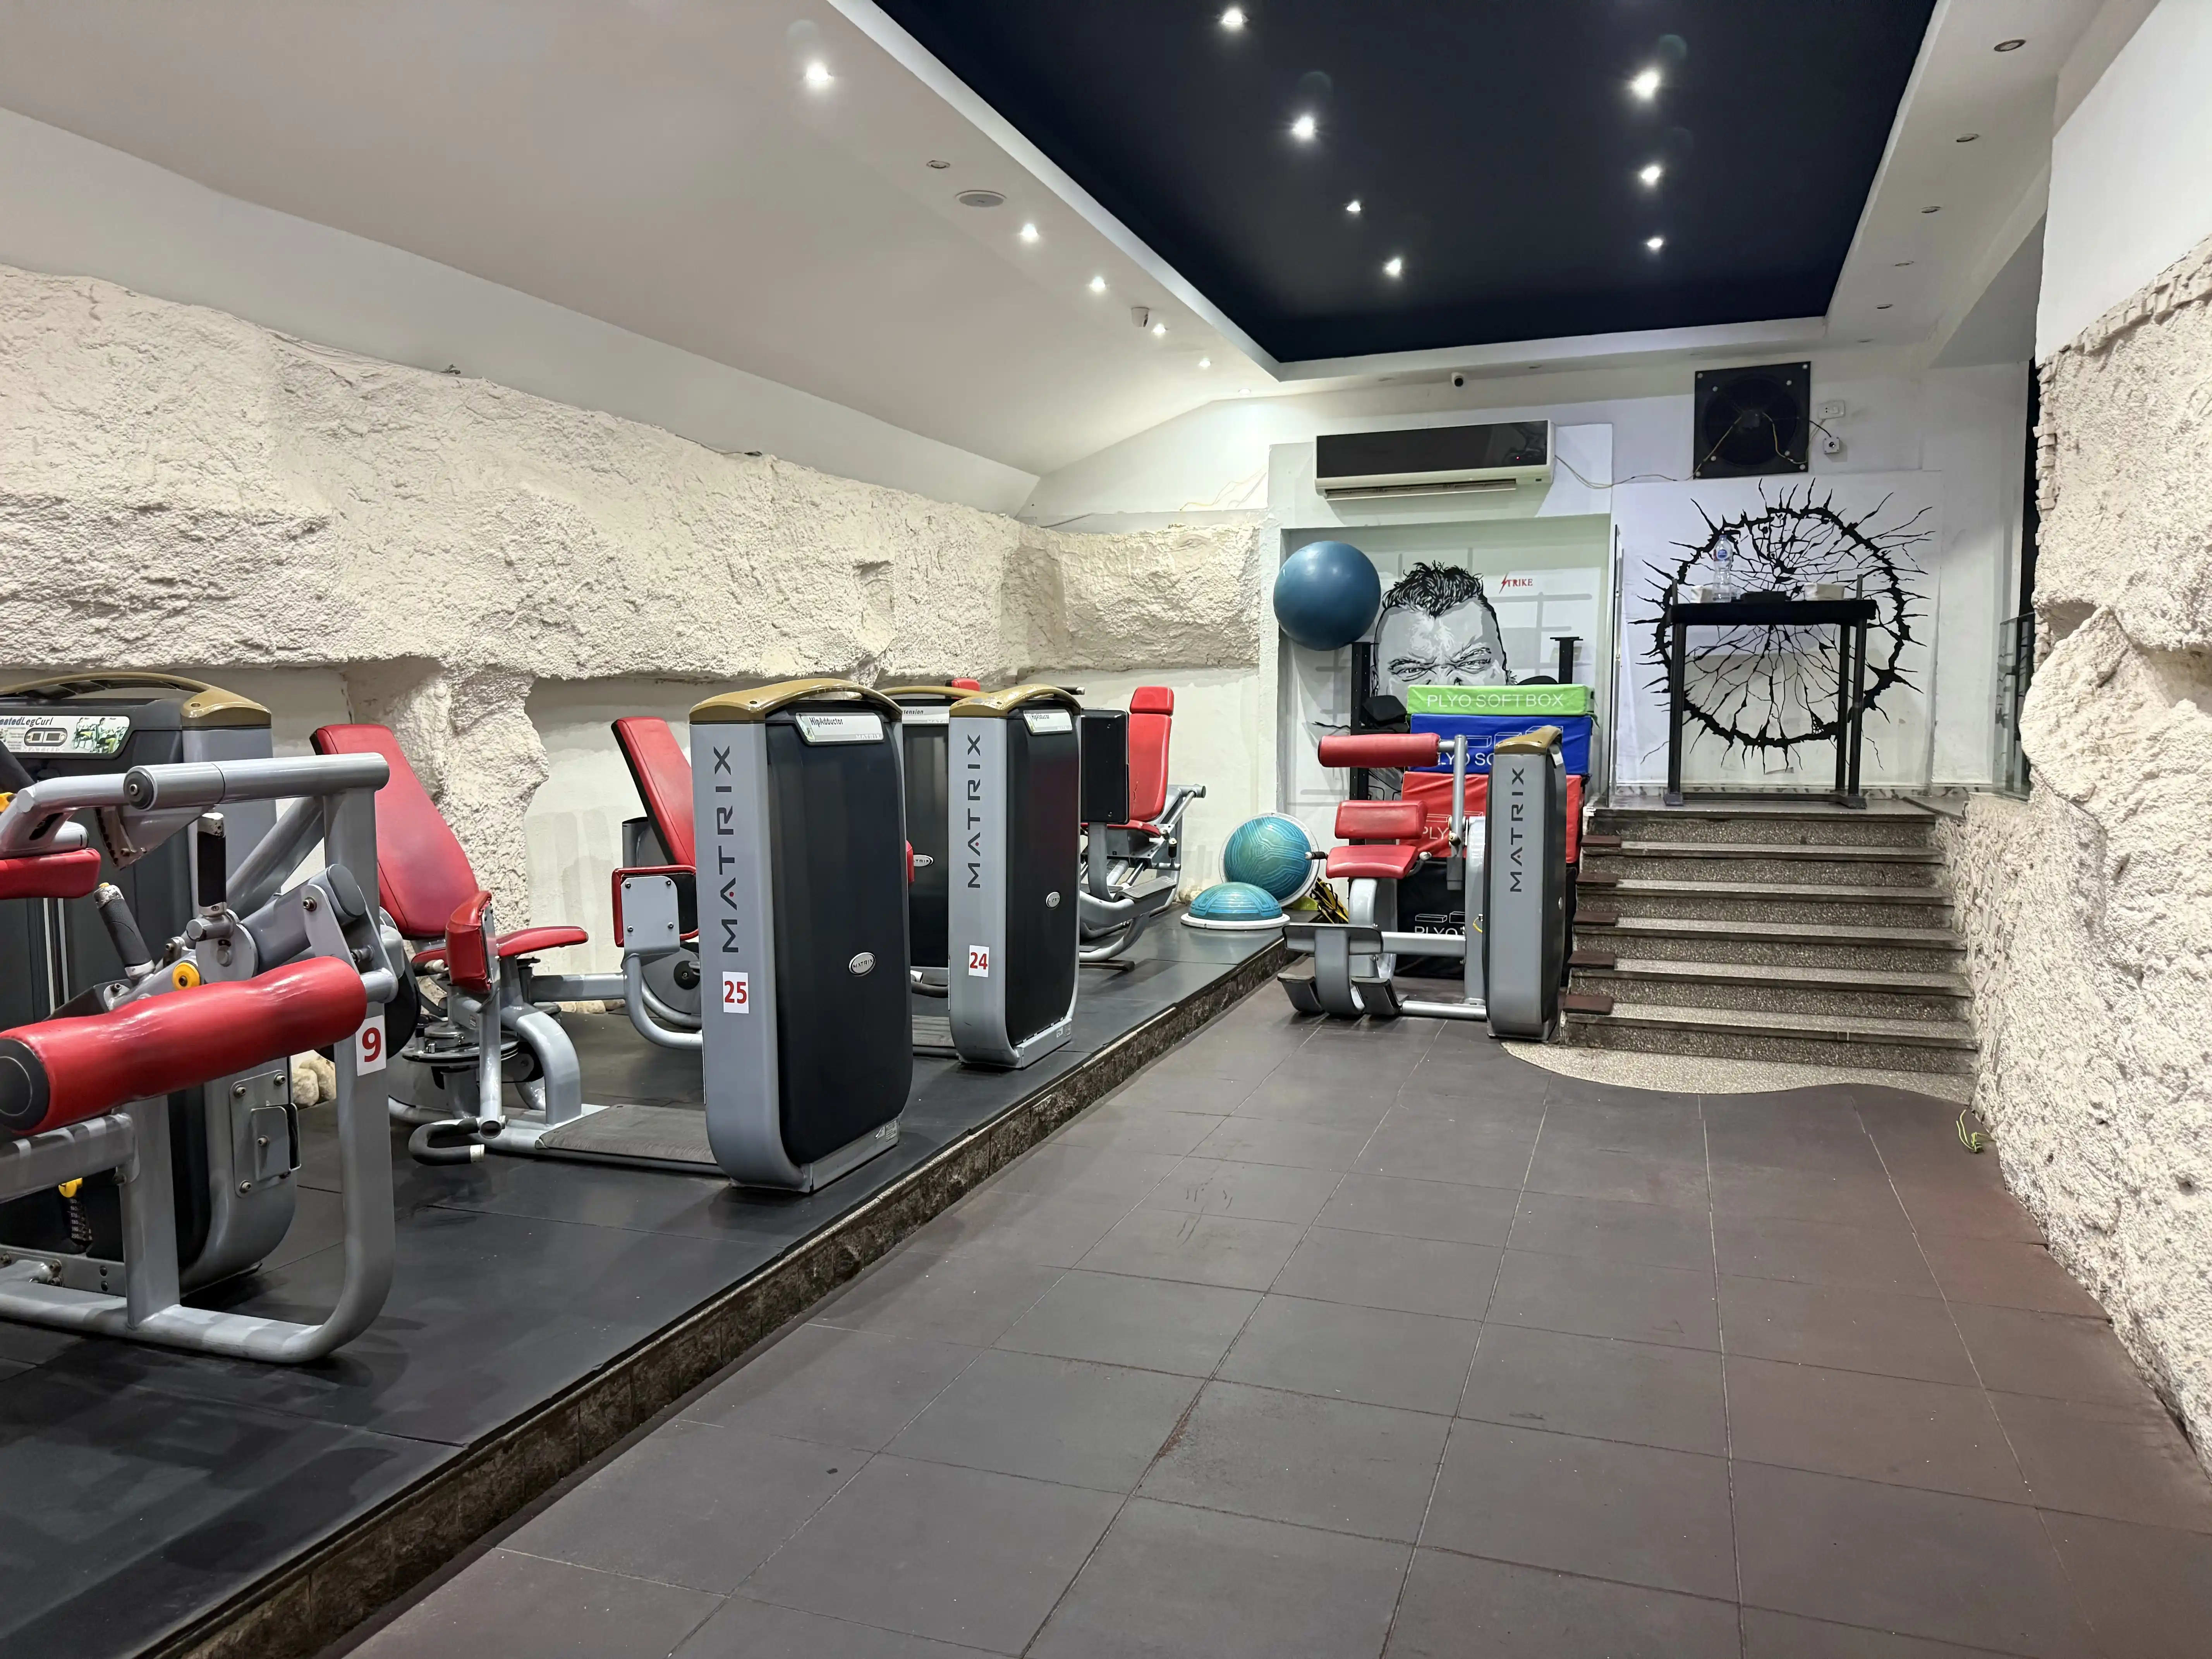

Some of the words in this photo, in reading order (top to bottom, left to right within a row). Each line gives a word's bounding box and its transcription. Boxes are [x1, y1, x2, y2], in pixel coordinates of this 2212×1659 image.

[1427, 694, 1471, 707] PLYO
[1476, 694, 1523, 708] SOFT
[1526, 694, 1564, 707] BOX
[0, 717, 53, 726] eatedLegCurl
[809, 717, 843, 727] HipAdductor
[967, 734, 981, 888] MATRIX
[1510, 768, 1524, 892] MATRIX
[713, 745, 739, 953] MATRIX
[853, 959, 873, 968] MATRIX
[970, 952, 988, 970] 24
[724, 981, 747, 1004] 25
[362, 1027, 381, 1062] 9
